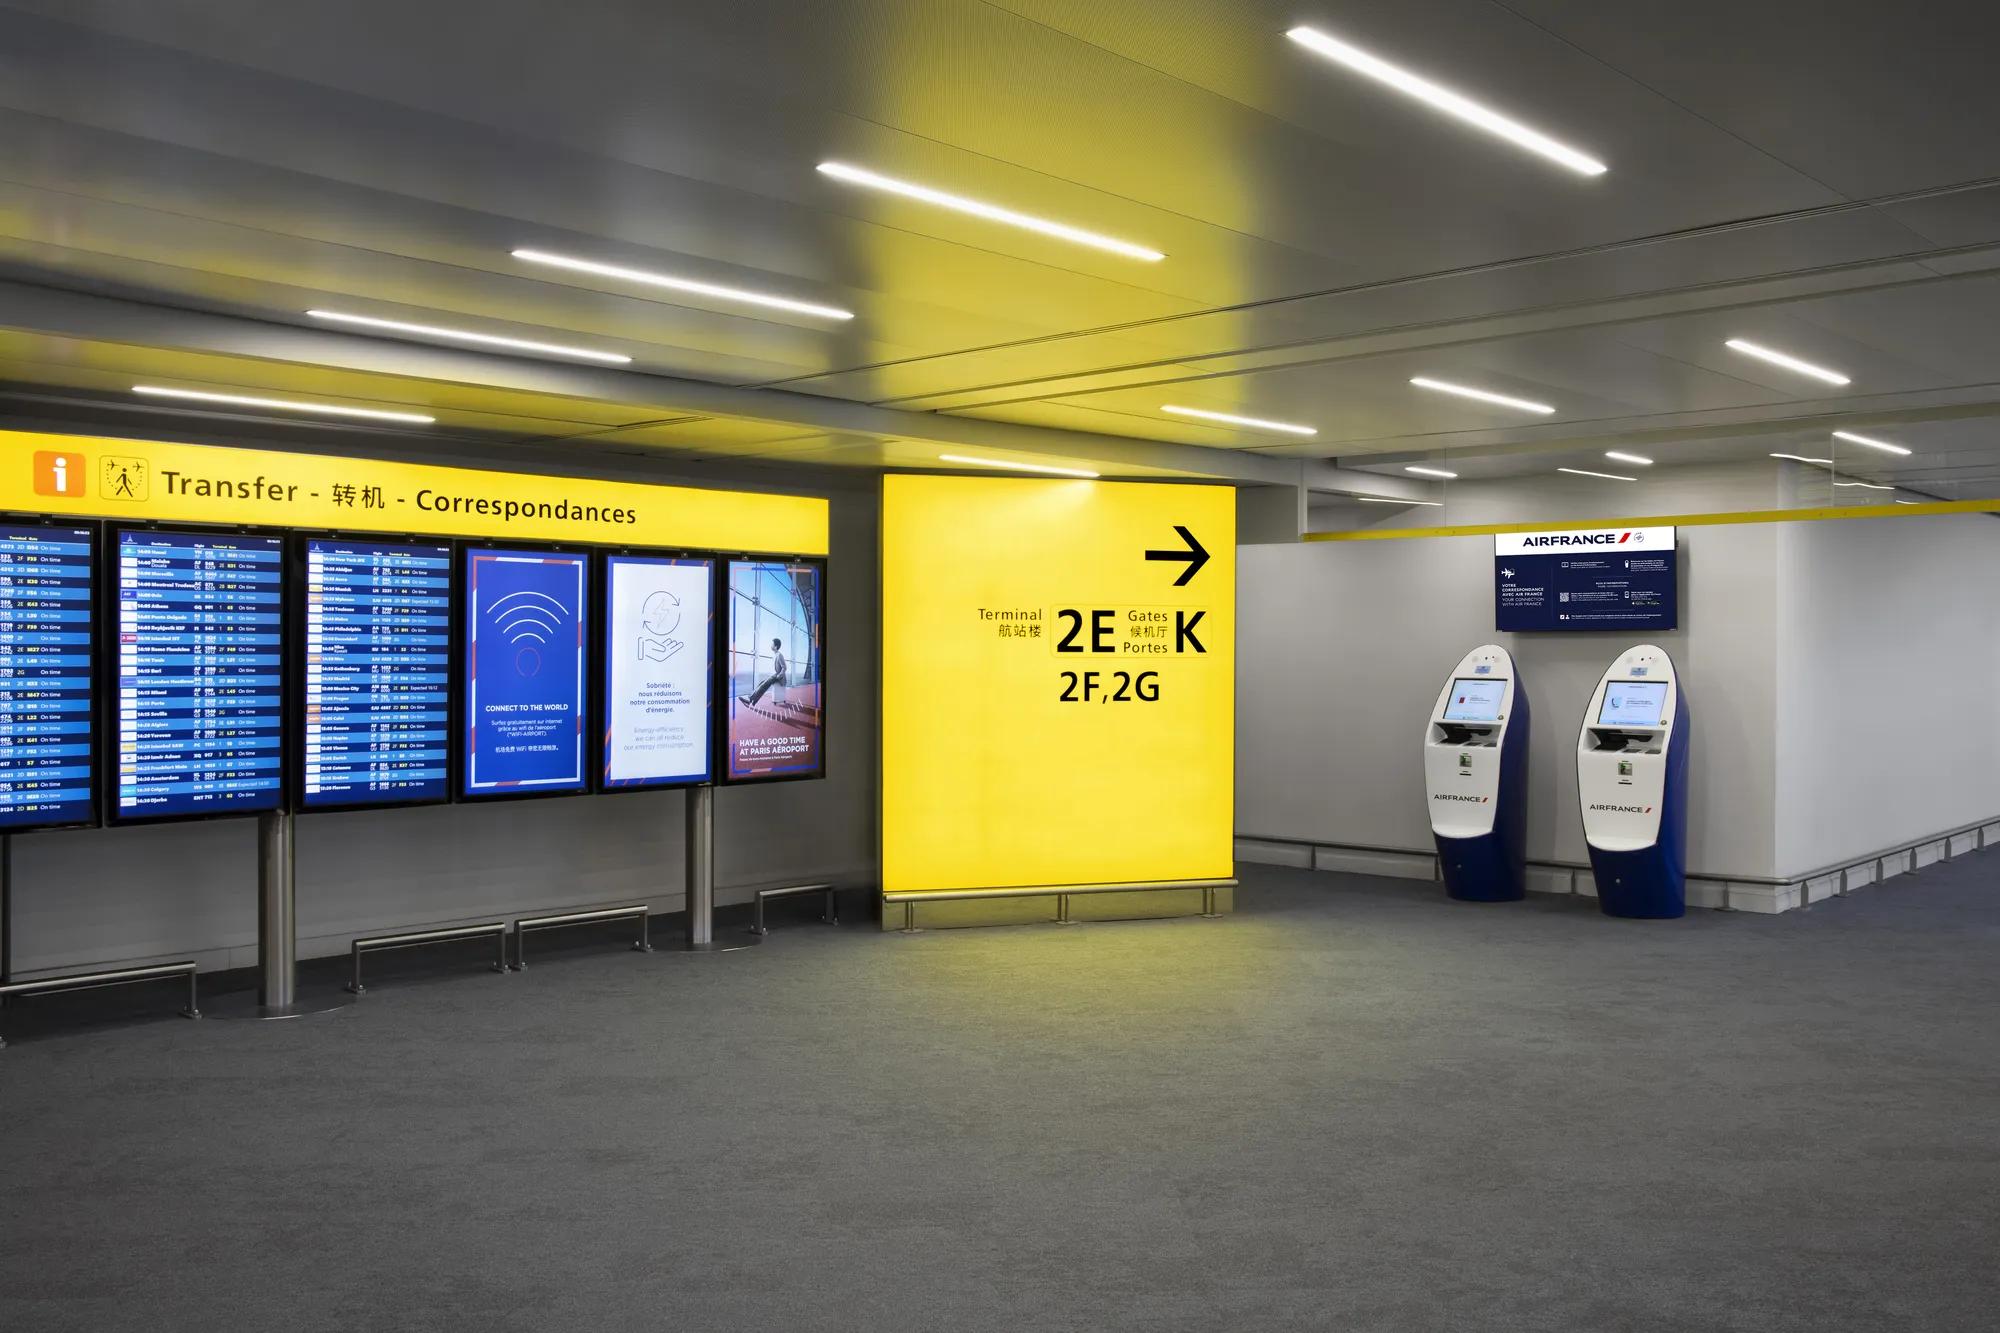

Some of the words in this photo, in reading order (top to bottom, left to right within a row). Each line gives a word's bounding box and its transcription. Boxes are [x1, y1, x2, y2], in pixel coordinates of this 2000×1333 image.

[161, 470, 298, 503] Transfer
[332, 482, 385, 510] 转机
[416, 489, 636, 525] Correspondances
[1523, 534, 1615, 547] AIRFRANCE
[978, 608, 1042, 620] Terminal
[1056, 609, 1116, 653] 2E
[1128, 610, 1168, 622] Gates
[1175, 611, 1207, 653] K
[998, 623, 1042, 638] 航站楼
[1130, 625, 1168, 638] 候机厅
[1123, 642, 1168, 654] Portes
[1059, 671, 1159, 704] 2F,2G
[485, 704, 518, 712] CONNECT
[740, 739, 758, 747] HAVE
[767, 737, 788, 745] GOOD
[790, 736, 806, 744] TIME
[740, 748, 749, 756] AT
[750, 747, 771, 755] PARIS
[772, 744, 809, 754] AÉROPORT
[1434, 794, 1481, 803] AIRFRANCE
[1589, 804, 1643, 813] AIRFRANCE
